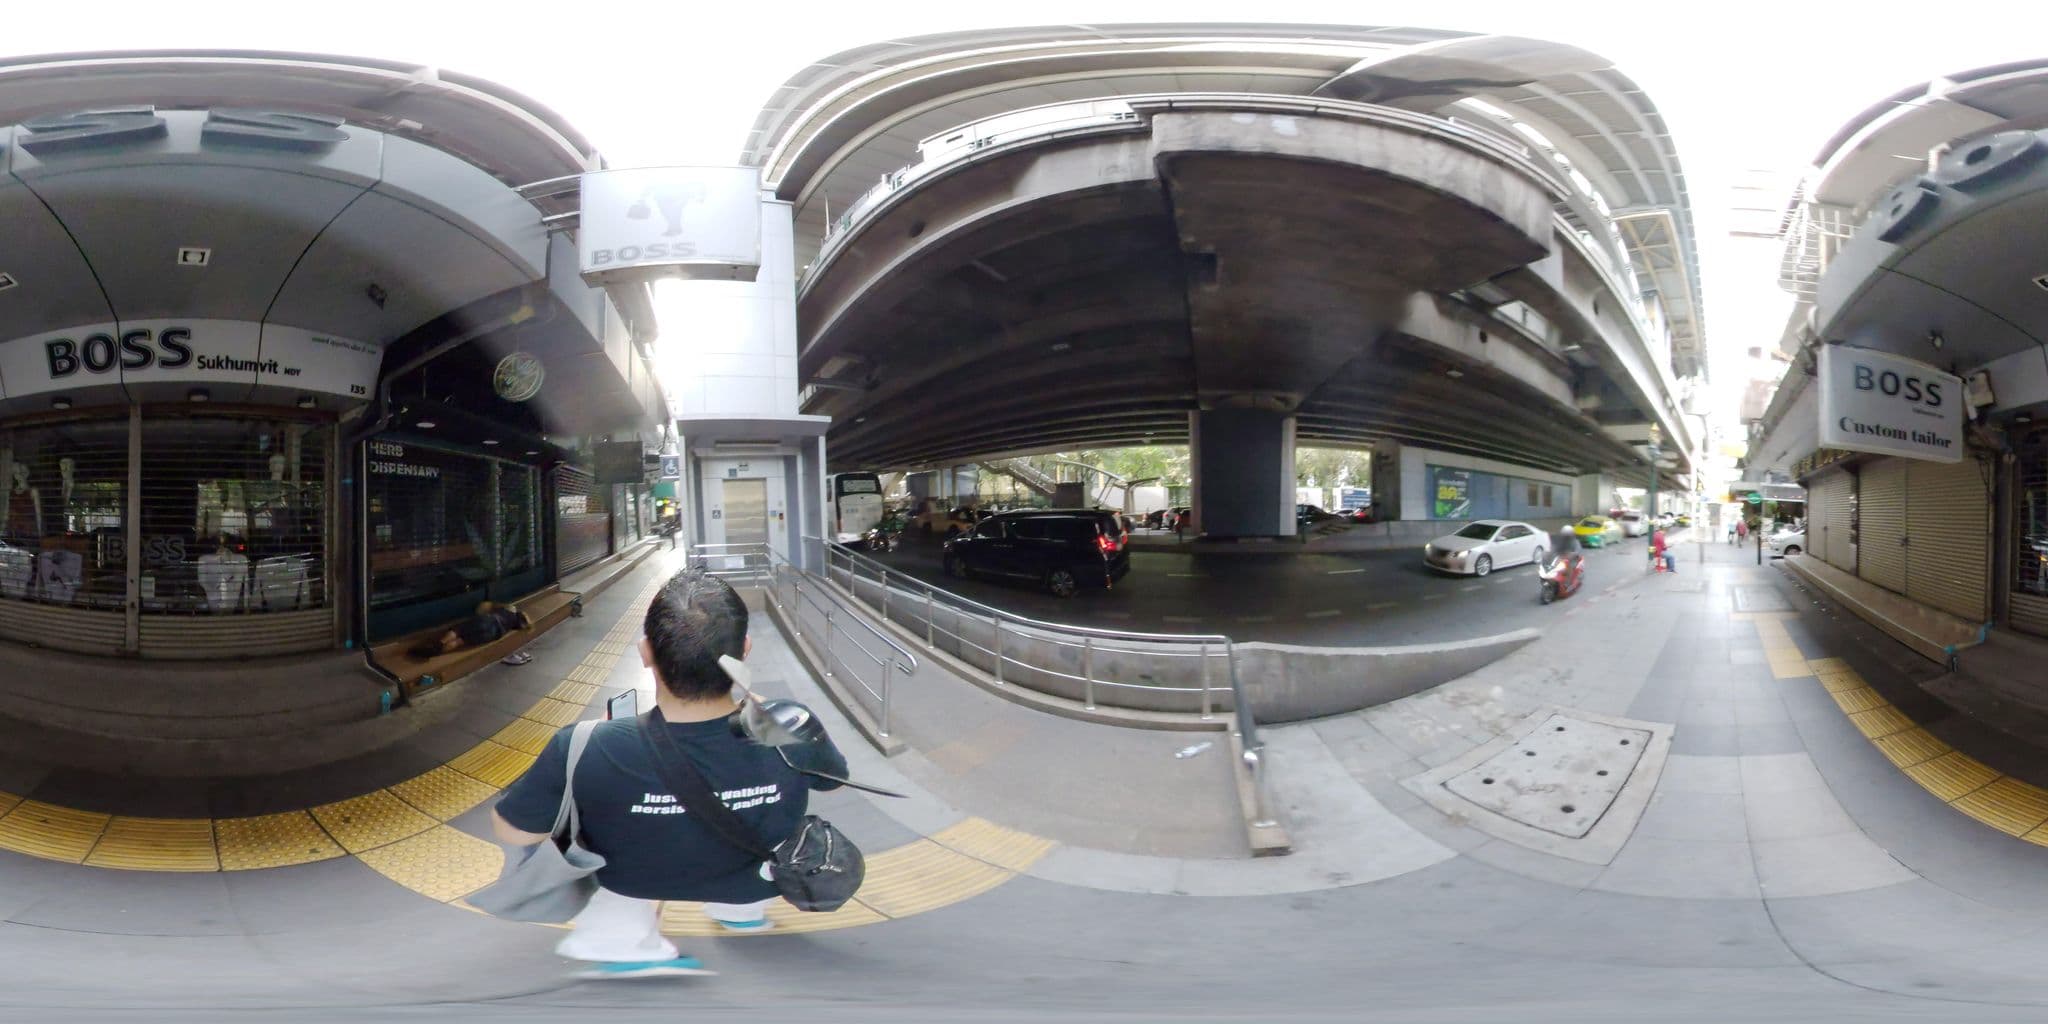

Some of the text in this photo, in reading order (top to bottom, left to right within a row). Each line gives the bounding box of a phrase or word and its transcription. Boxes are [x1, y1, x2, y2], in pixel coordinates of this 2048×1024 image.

[591, 242, 697, 265] BOSS
[46, 327, 193, 379] BOSS
[197, 355, 279, 374] Sukhumvit
[350, 383, 366, 395] 135
[1855, 365, 1942, 407] BOSS
[1839, 416, 1952, 448] Custom tailor
[370, 441, 404, 457] HERB
[107, 535, 187, 562] BSS
